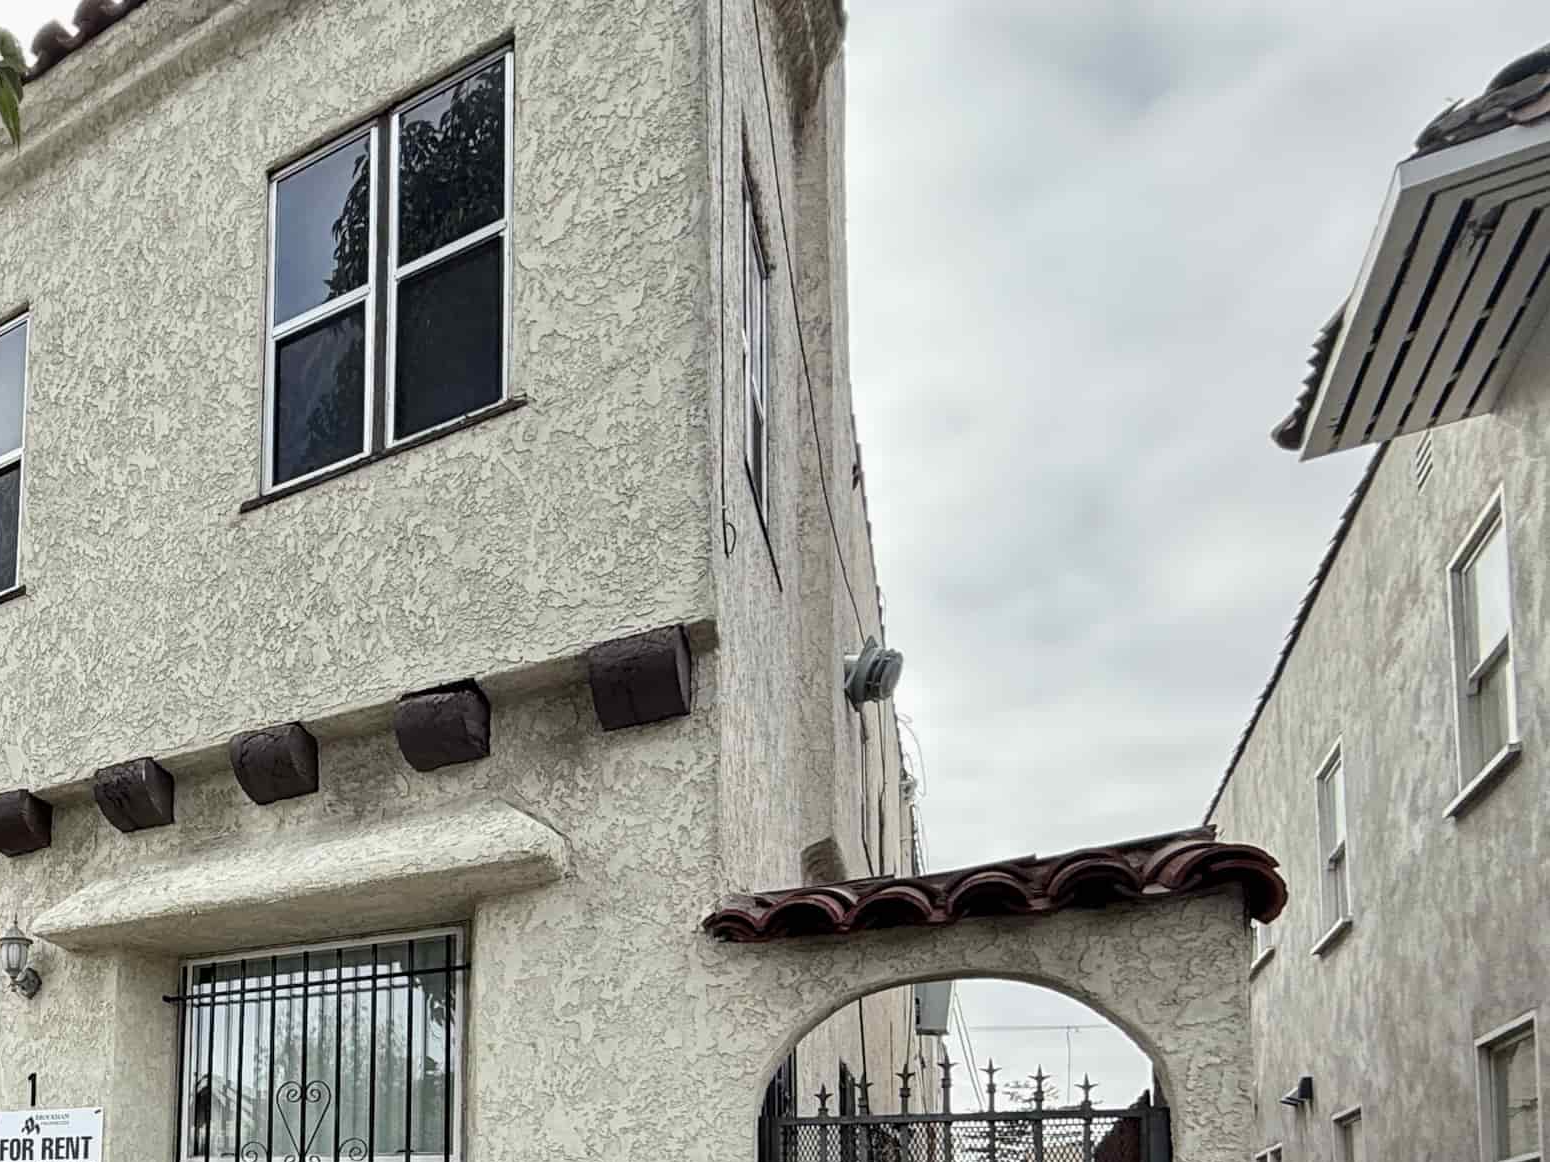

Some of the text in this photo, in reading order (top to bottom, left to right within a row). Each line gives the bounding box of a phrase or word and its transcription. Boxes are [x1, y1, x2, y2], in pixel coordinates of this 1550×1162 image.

[27, 1072, 37, 1107] 1
[0, 1136, 93, 1161] FOR RENT
